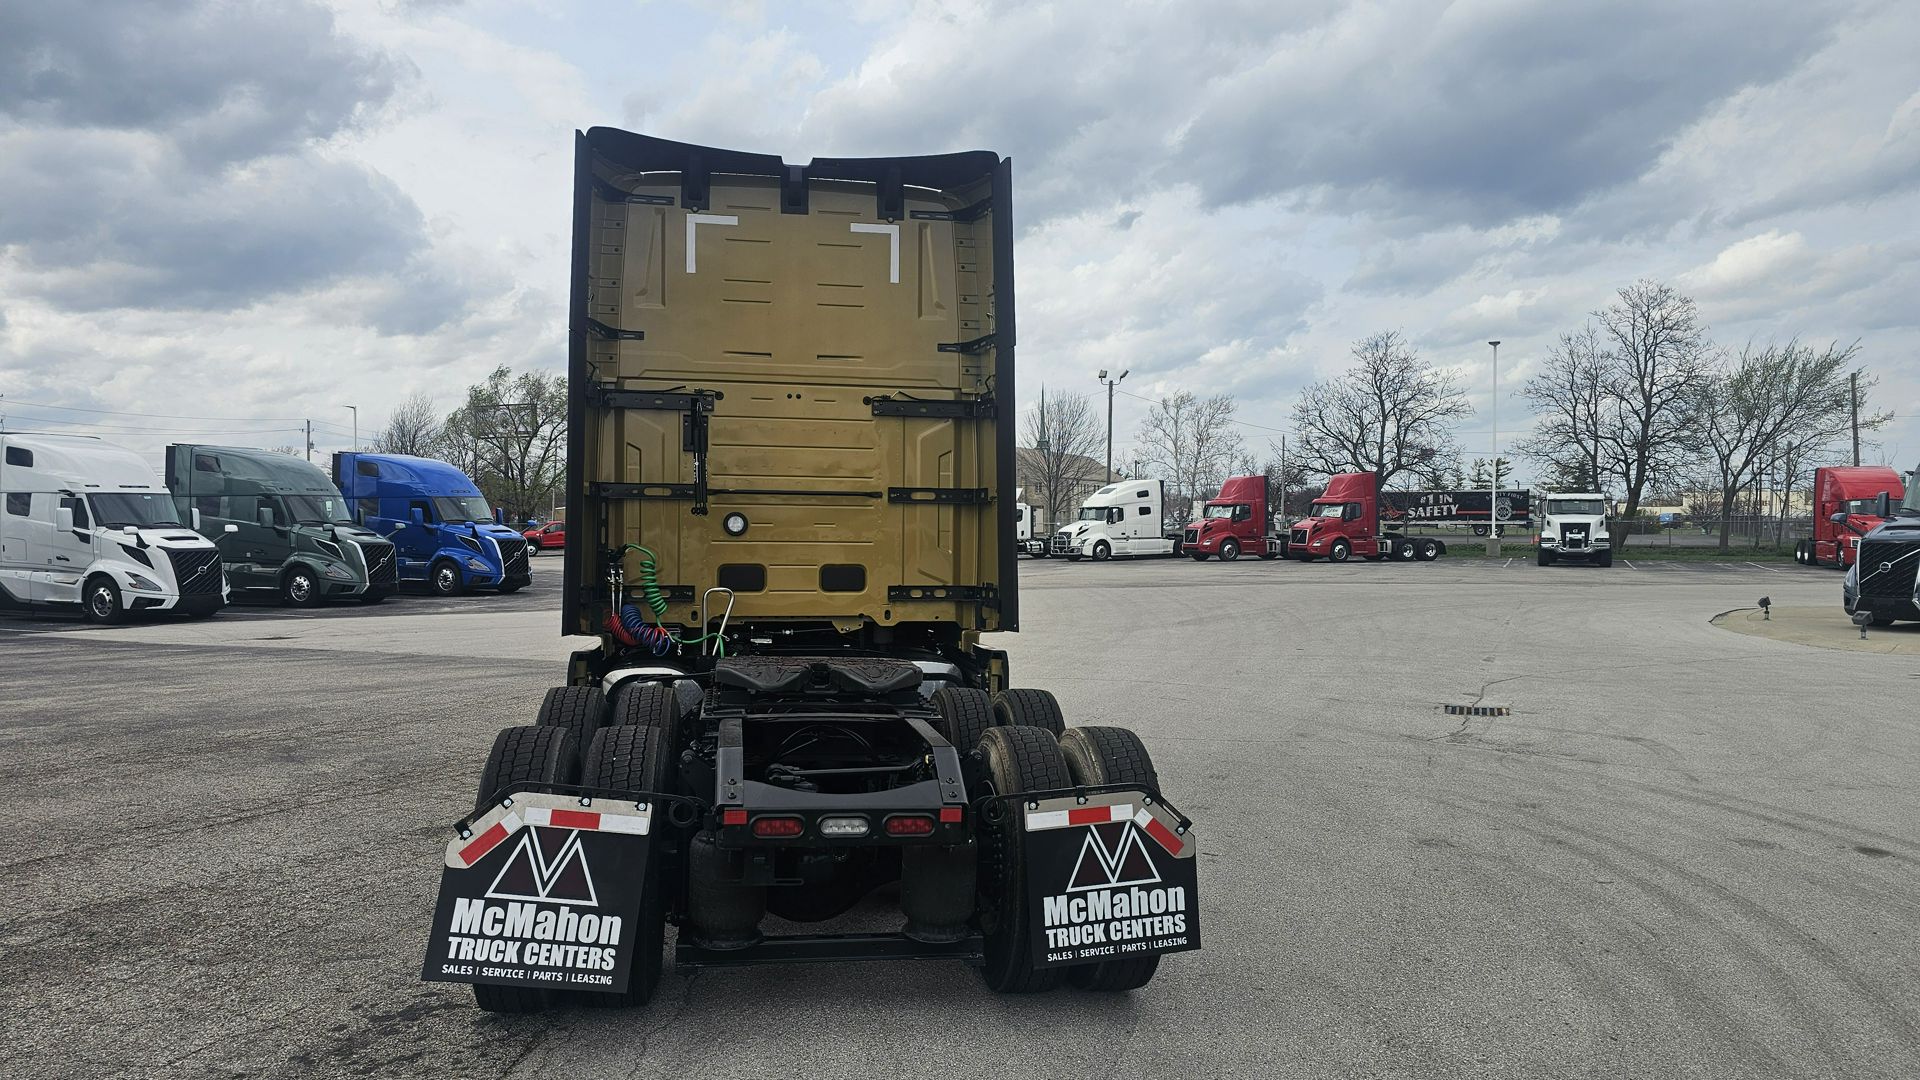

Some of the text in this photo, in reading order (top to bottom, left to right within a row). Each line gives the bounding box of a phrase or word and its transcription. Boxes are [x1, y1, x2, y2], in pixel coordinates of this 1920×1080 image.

[1407, 504, 1459, 518] SAFETY
[1420, 494, 1453, 505] #1 IN
[449, 897, 622, 945] McMahon
[1043, 886, 1186, 927] McMahon
[1045, 913, 1187, 949] TRUCK CENTERS
[447, 936, 617, 971] TRUCK CENTERS
[1047, 936, 1188, 962] SALES SERVICE PARTS LEASING
[441, 964, 613, 985] SALES SERVICE PARTS LEASING
